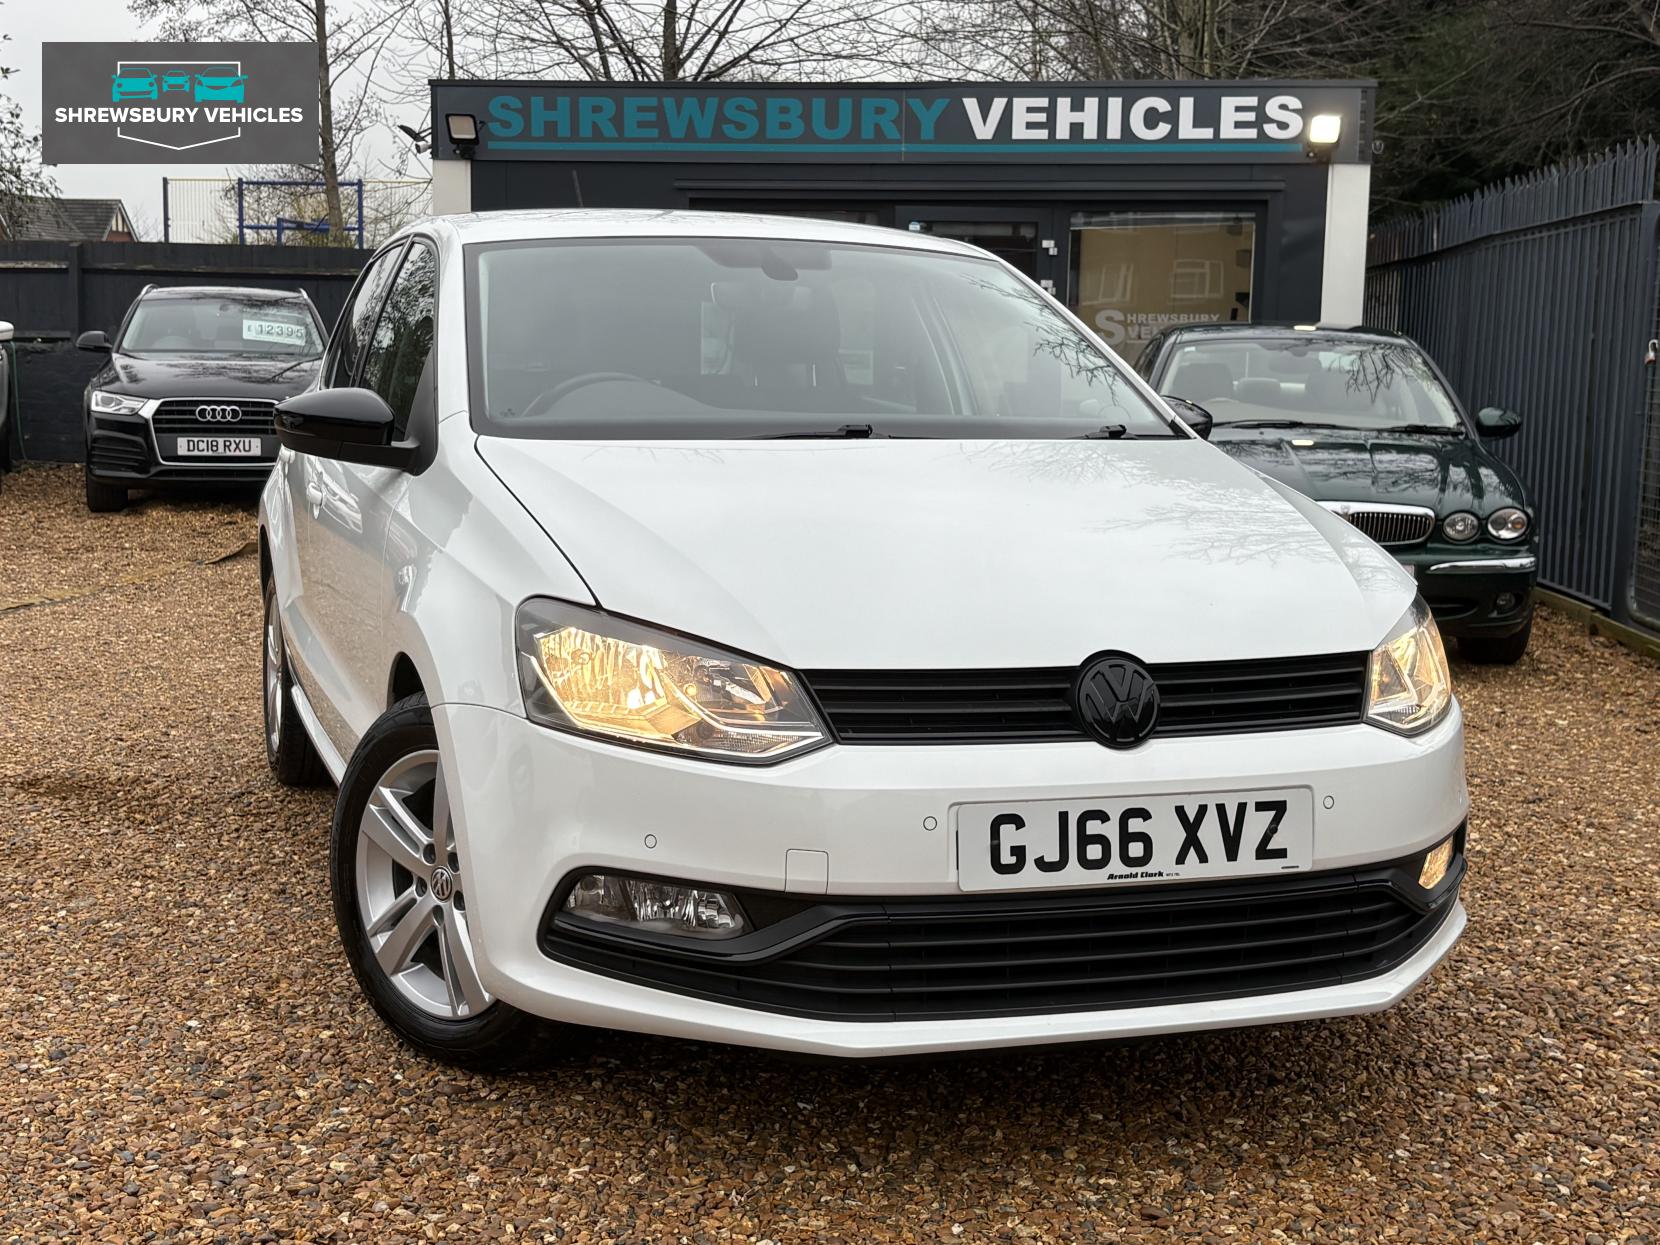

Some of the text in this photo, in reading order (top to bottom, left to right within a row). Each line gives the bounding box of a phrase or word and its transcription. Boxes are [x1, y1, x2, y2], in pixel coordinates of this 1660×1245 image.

[488, 95, 1304, 141] SHREWSBURY VEHICLES
[186, 439, 252, 453] DC18 RXU
[989, 799, 1289, 875] GJ66 XVZ
[1107, 871, 1139, 880] Arnold
[1140, 870, 1164, 878] Clark
